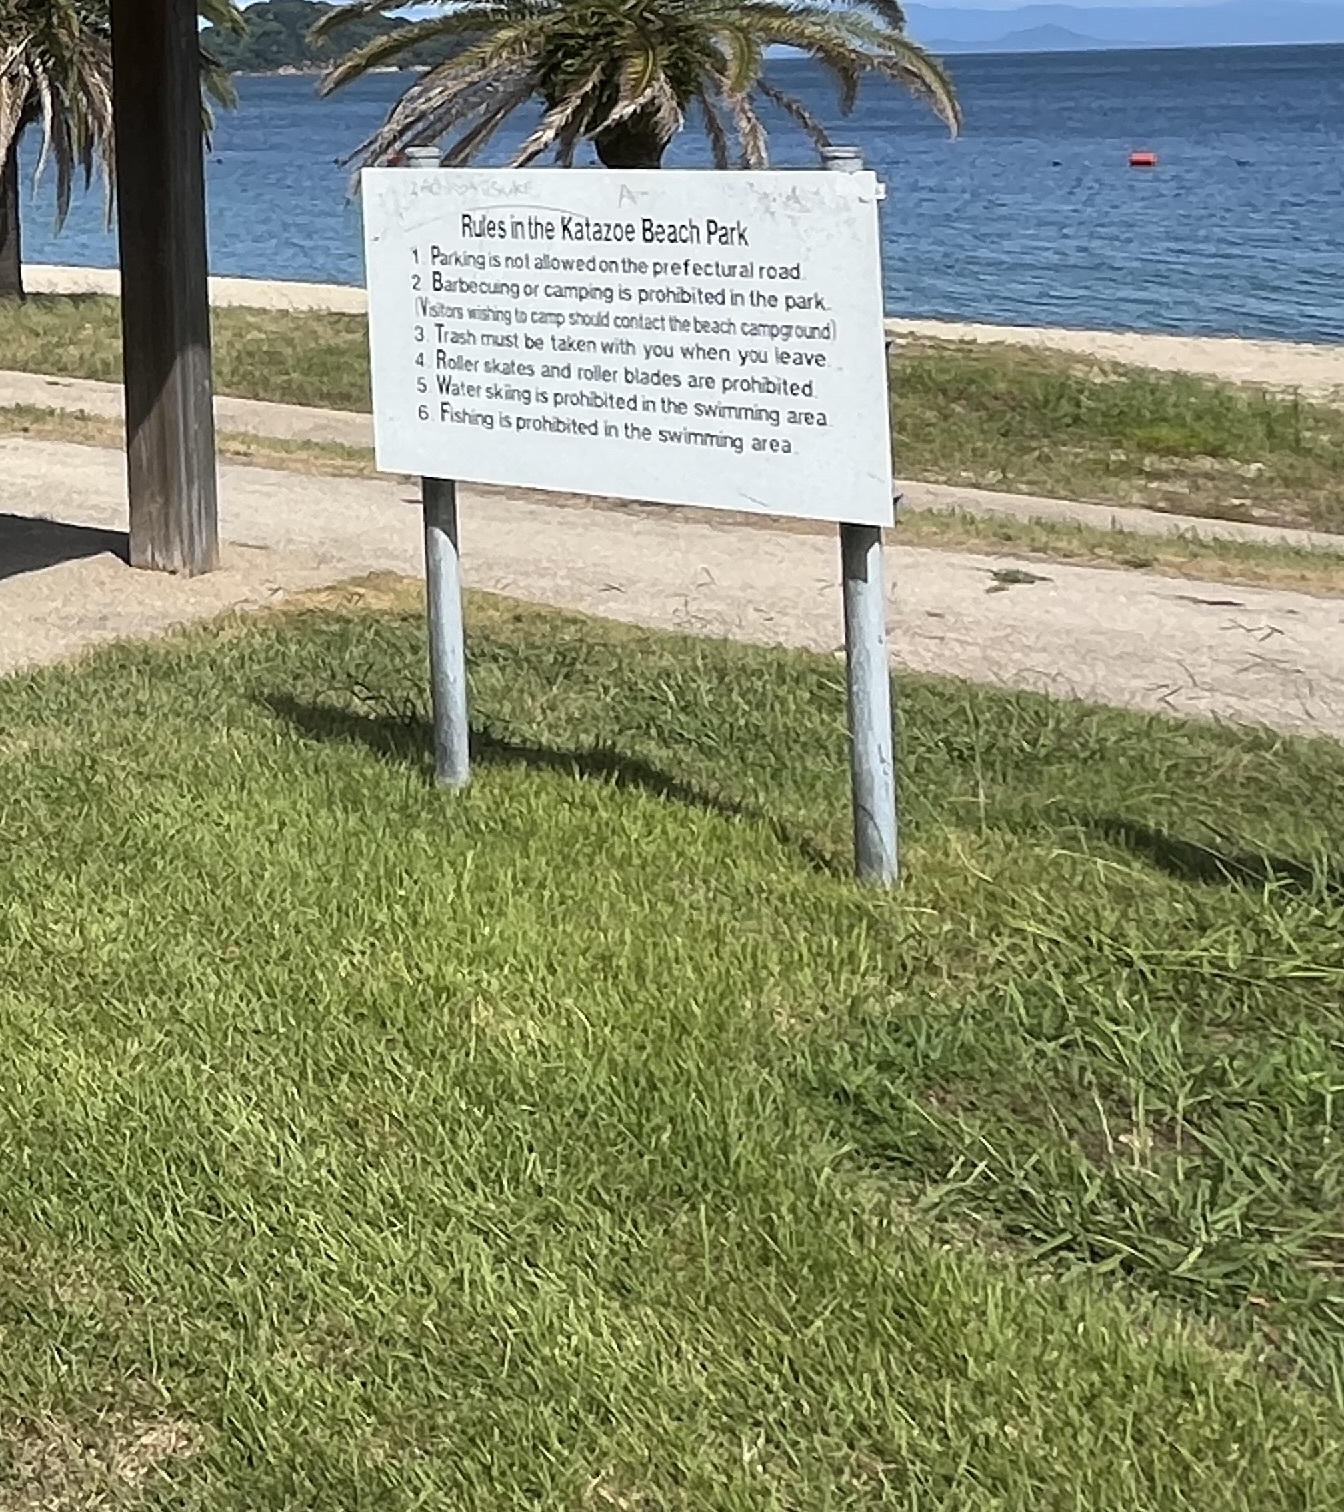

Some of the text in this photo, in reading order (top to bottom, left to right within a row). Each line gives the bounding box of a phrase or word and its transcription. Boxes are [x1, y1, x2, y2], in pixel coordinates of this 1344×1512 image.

[462, 214, 749, 247] Rules in the Katazoe Beach Park
[431, 245, 486, 270] Parking
[488, 249, 501, 267] is
[505, 253, 530, 269] not
[534, 254, 596, 272] allowed
[599, 257, 619, 273] on
[621, 257, 649, 275] the
[653, 259, 754, 281] prefectural
[432, 271, 520, 298] Barbecuing
[523, 284, 539, 297] or
[544, 283, 613, 303] camping
[618, 284, 632, 301] is
[638, 286, 726, 305] prohibited
[730, 288, 746, 306] in
[749, 290, 779, 308] the
[415, 296, 837, 341] (Visitors wishing to camp should contact the beach campground)
[434, 323, 477, 345] Trash
[480, 332, 519, 349] must
[524, 333, 544, 350] be
[551, 335, 596, 353] taken
[600, 338, 636, 356] with
[643, 343, 674, 360] you
[680, 343, 731, 361] when
[738, 349, 768, 366] you
[436, 349, 480, 372] Roller
[484, 359, 535, 376] skates
[540, 363, 571, 379] and
[577, 365, 618, 382] roller
[624, 367, 681, 388] blades
[687, 374, 715, 389] are
[436, 375, 482, 397] Water
[485, 384, 532, 405] skiing
[535, 387, 548, 403] is
[553, 390, 638, 412] prohibited
[642, 395, 656, 412] in
[661, 397, 688, 415] the
[694, 400, 780, 426] swimming
[440, 401, 494, 429] Fishing
[499, 411, 512, 427] is
[516, 415, 598, 436] prohibited
[604, 419, 619, 438] in
[624, 422, 652, 441] the
[658, 426, 744, 454] swimming
